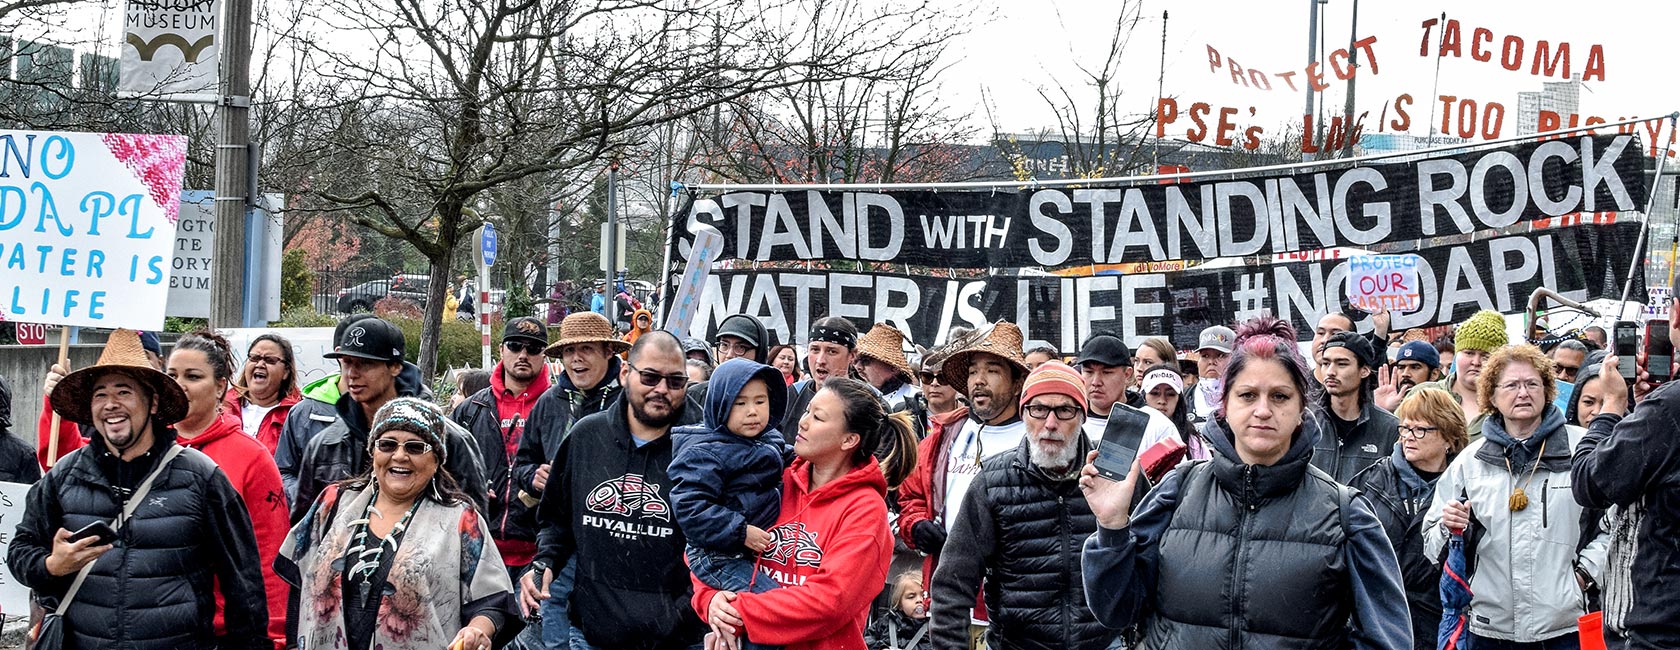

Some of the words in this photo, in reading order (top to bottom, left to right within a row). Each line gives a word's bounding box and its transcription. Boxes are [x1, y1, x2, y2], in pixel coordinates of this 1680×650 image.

[126, 13, 214, 30] MUSEUM
[1206, 36, 1378, 91] PROTECT
[1420, 18, 1605, 81] TACOMA
[1156, 98, 1264, 150] PSE's
[1377, 94, 1413, 132] IS
[1438, 95, 1505, 140] TOO
[0, 135, 75, 179] NO
[678, 190, 905, 261] STAND
[920, 215, 1011, 249] WITH
[1028, 166, 1392, 266] STANDING
[1417, 135, 1635, 235] ROCK
[0, 243, 106, 278] ATER
[129, 255, 163, 284] IS
[172, 257, 212, 270] ORY
[1350, 256, 1419, 270] PROTECT
[170, 276, 210, 290] EUM
[1360, 272, 1409, 295] OUR
[11, 286, 106, 319] LIFE
[677, 272, 920, 352] WATER
[933, 280, 989, 347] IS
[1016, 273, 1169, 354] LIFE
[19, 322, 45, 340] STO
[582, 514, 674, 538] PUYALLUP
[609, 531, 638, 541] TRIBE
